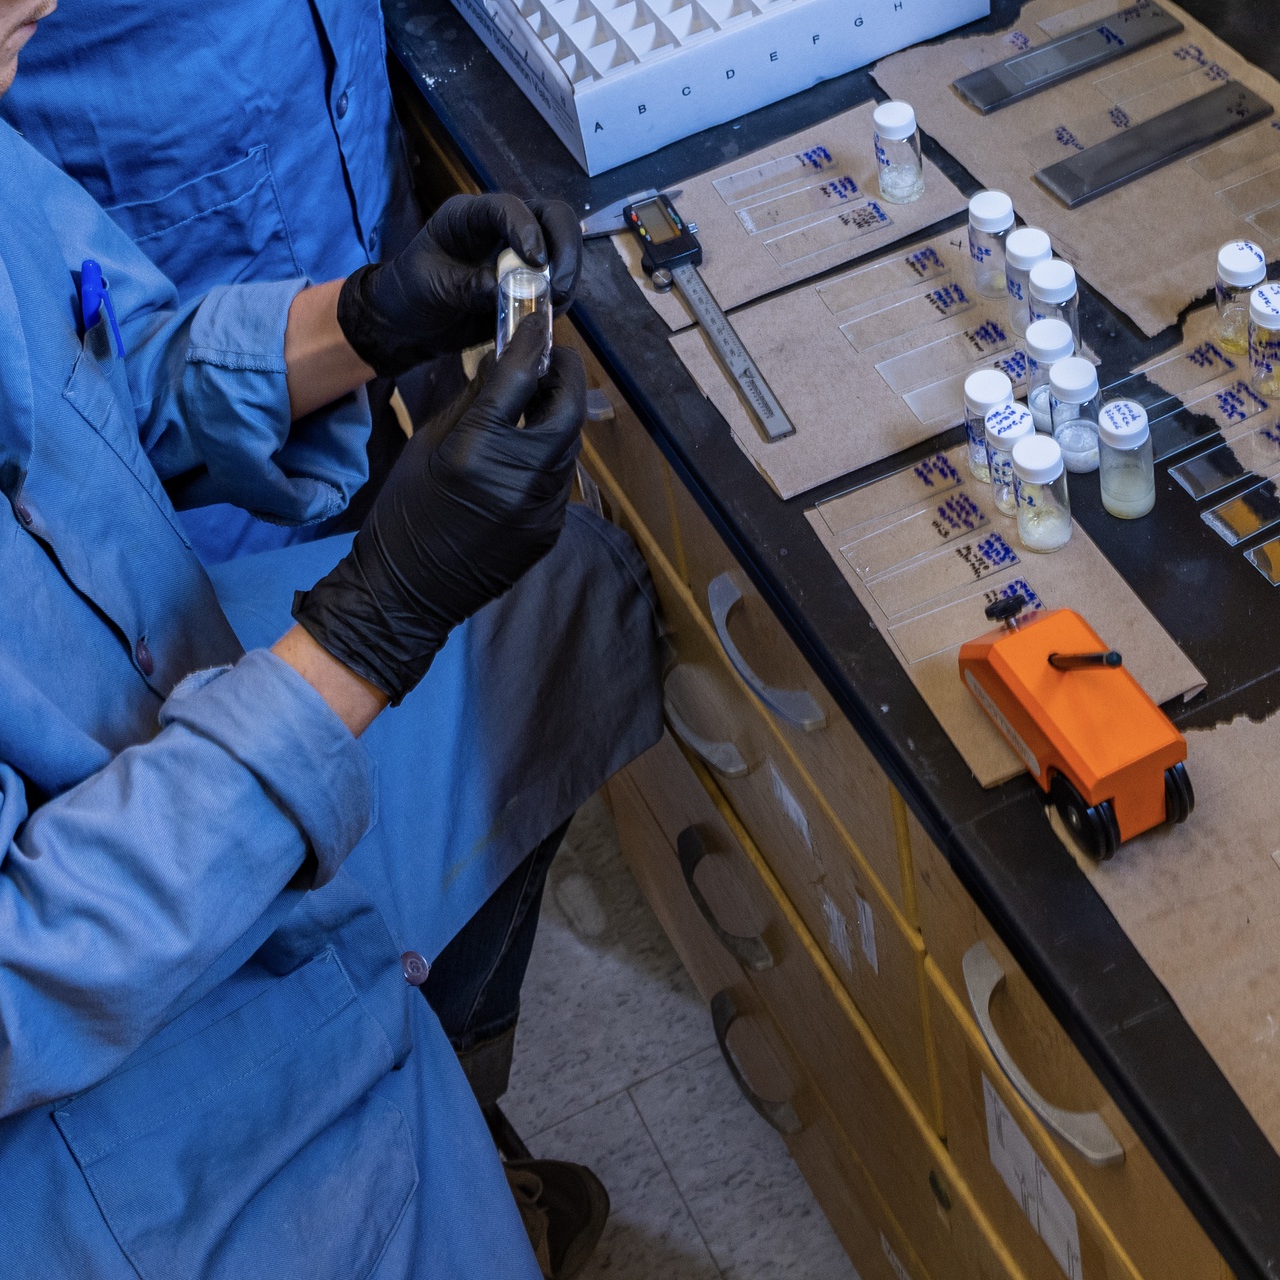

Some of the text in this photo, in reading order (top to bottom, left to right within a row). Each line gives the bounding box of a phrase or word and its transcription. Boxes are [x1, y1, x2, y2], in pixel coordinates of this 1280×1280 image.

[593, 121, 604, 134] A
[638, 103, 648, 116] B
[681, 85, 692, 97] C
[725, 68, 736, 80] D
[769, 51, 779, 63] E
[812, 34, 821, 46] F
[854, 17, 864, 28] G
[894, 1, 904, 12] H
